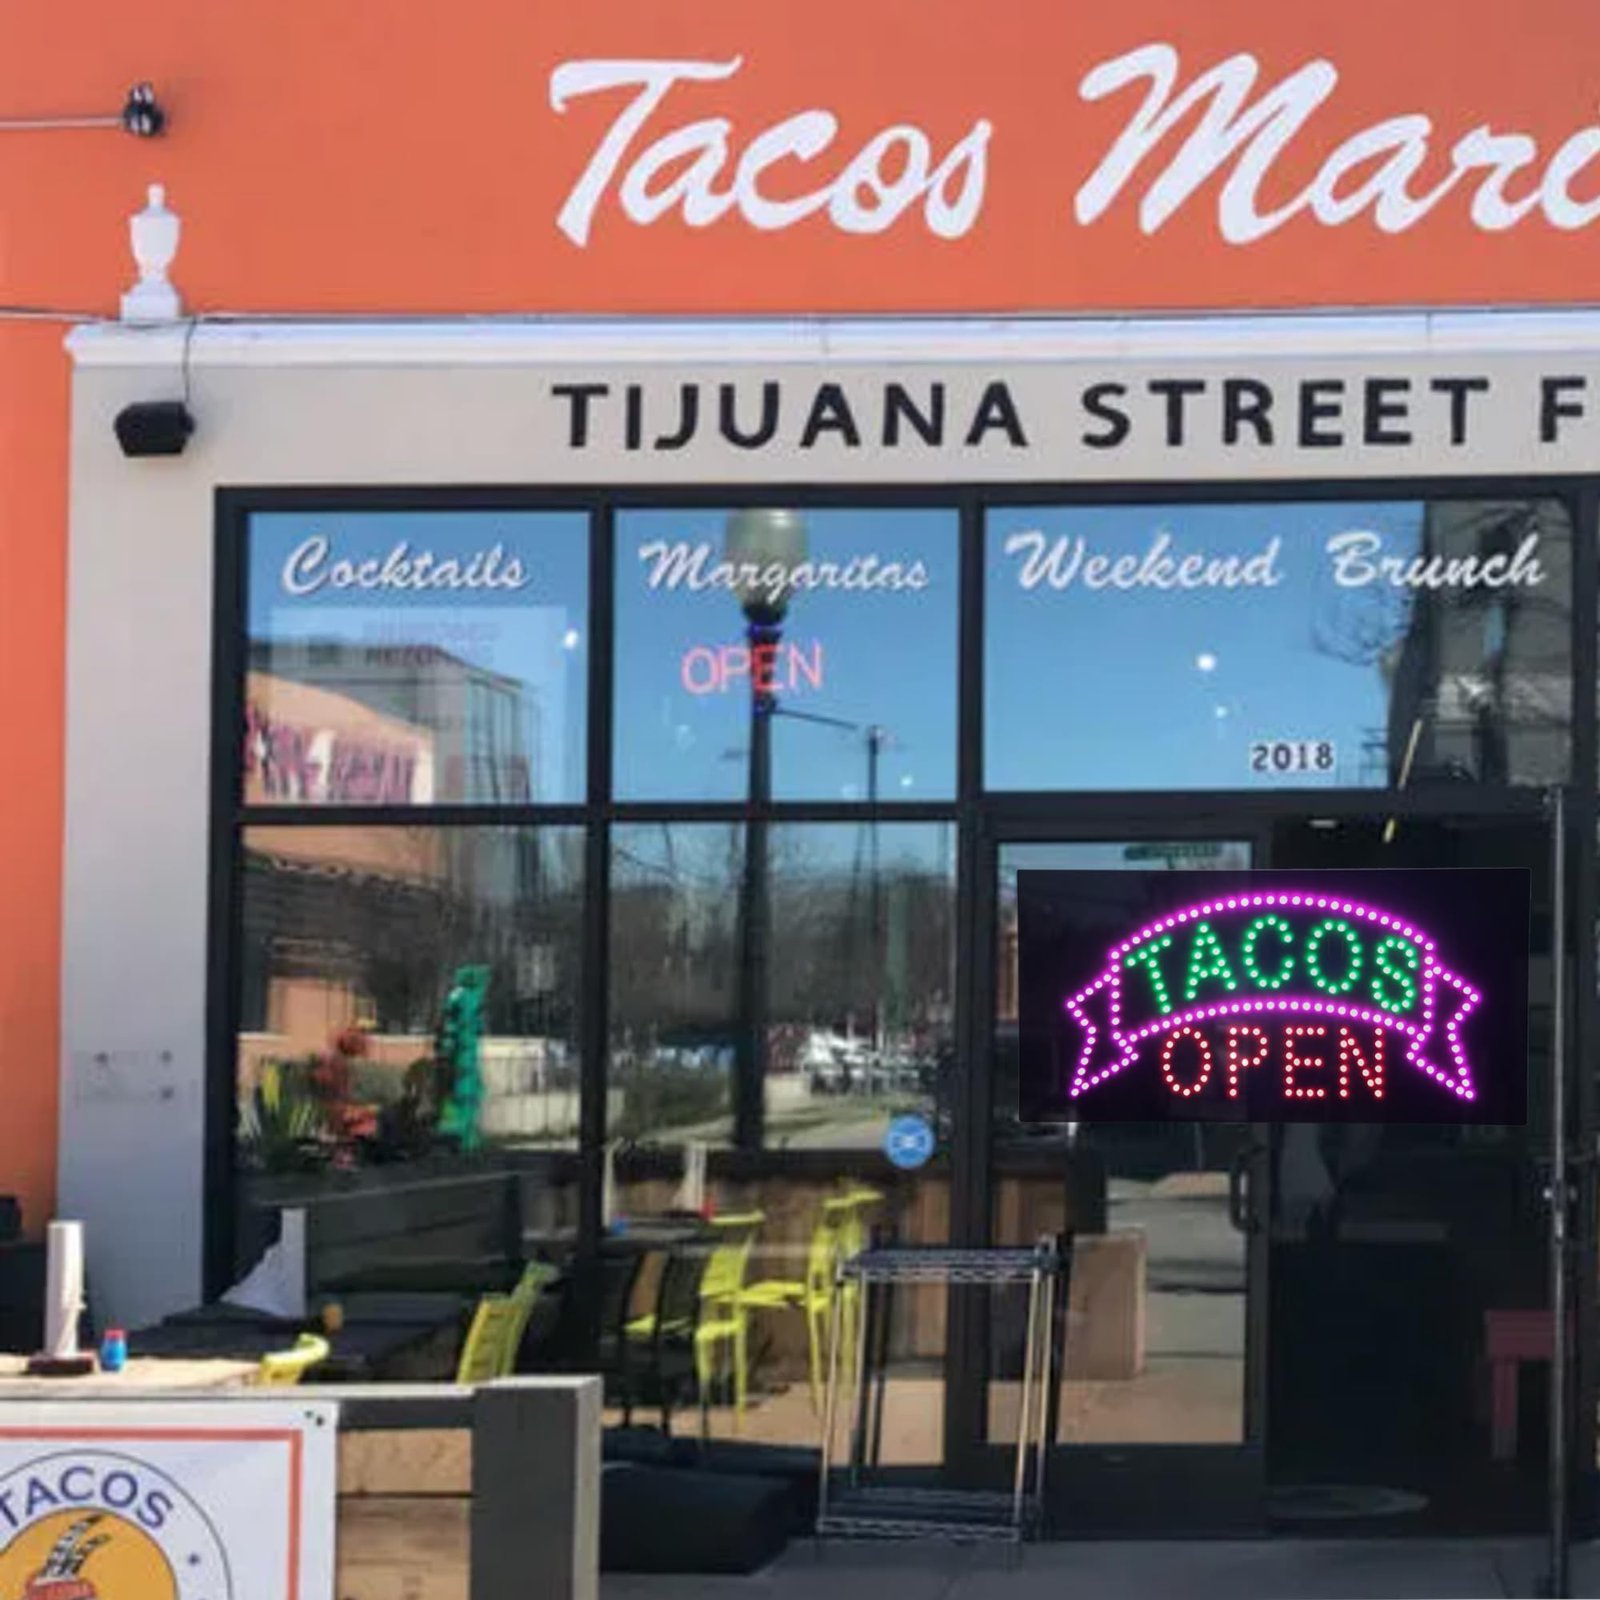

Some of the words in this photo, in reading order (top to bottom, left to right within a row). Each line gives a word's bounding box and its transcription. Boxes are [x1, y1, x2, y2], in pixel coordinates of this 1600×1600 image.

[548, 55, 992, 247] Tacos
[552, 381, 1028, 450] TIJUANA
[1082, 377, 1490, 448] STREET
[281, 534, 528, 595] Cocktails
[639, 541, 930, 603] Margaritas
[1004, 529, 1283, 590] Weekend
[1325, 529, 1546, 588] Brunch
[681, 640, 824, 695] OPEN
[1251, 742, 1335, 771] 2018
[1124, 914, 1420, 1014] TACOS
[1160, 1024, 1386, 1100] OPEN
